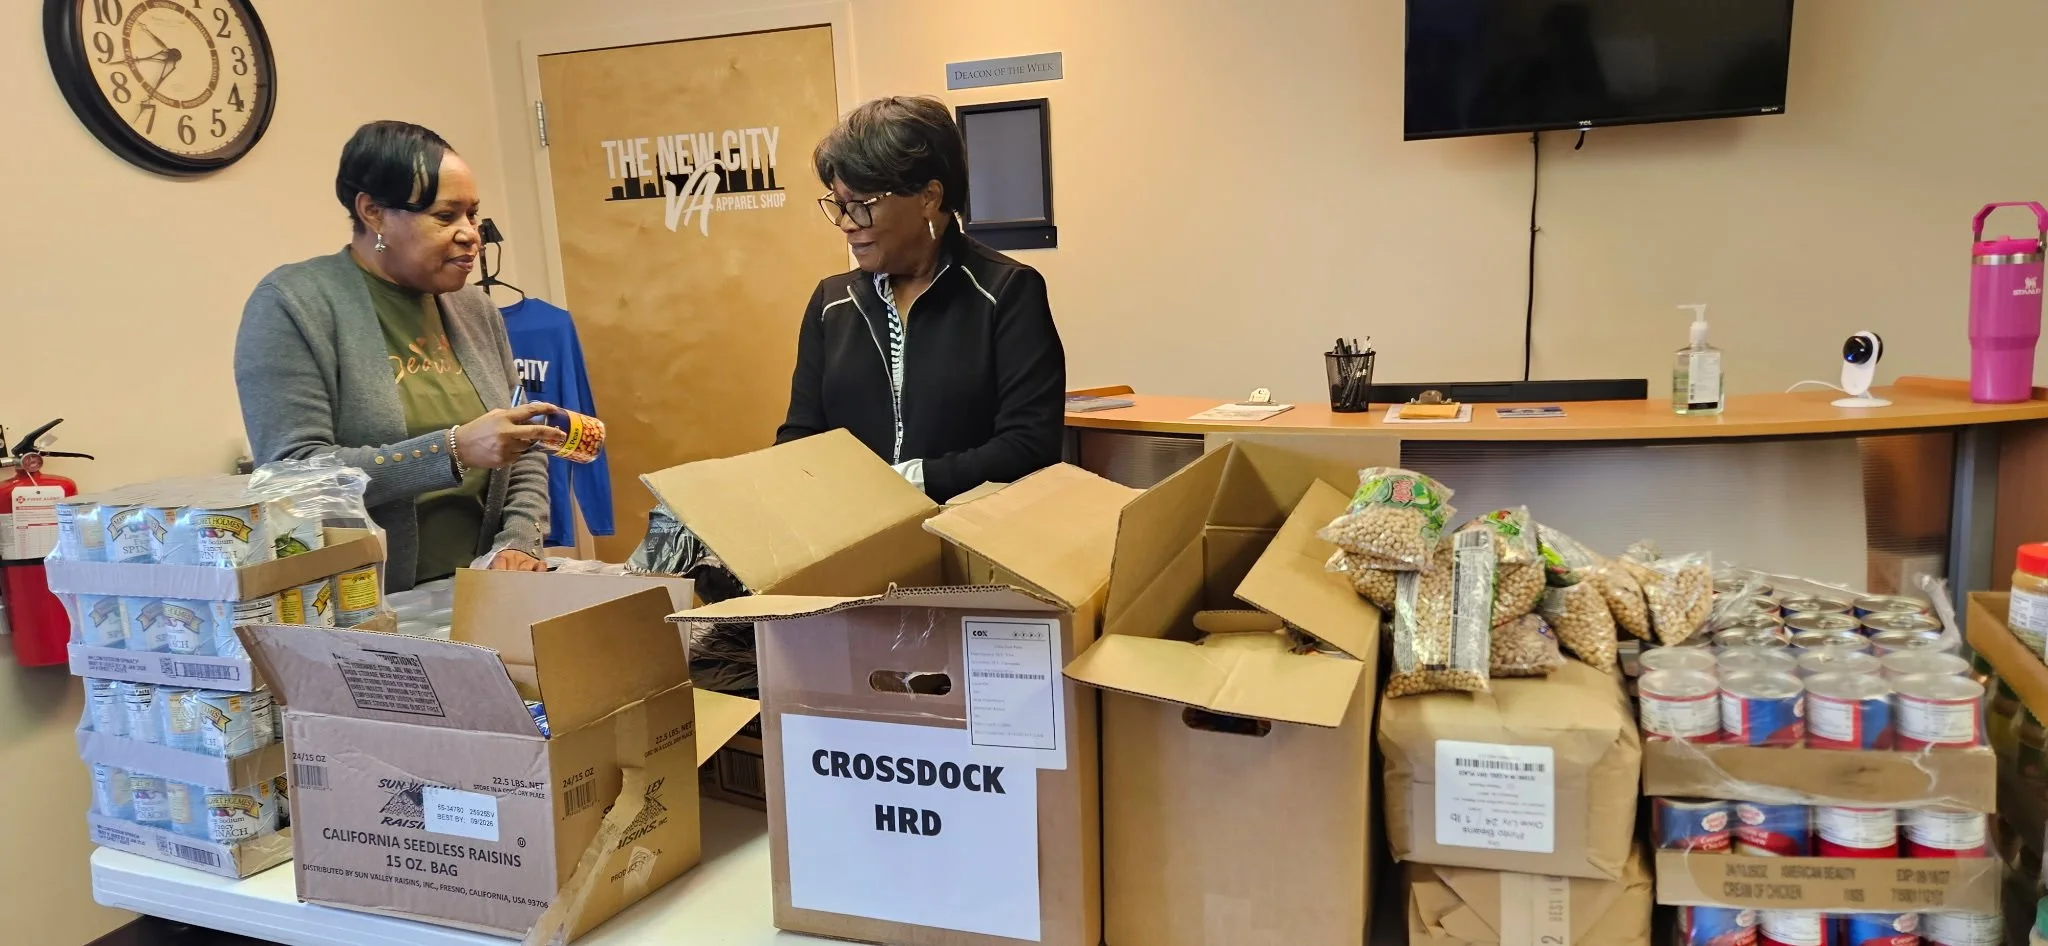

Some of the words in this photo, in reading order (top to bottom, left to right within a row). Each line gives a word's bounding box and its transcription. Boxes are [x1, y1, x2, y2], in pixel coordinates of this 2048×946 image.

[93, 0, 123, 27] 10
[213, 7, 232, 39] 2
[93, 31, 115, 64] 9
[231, 46, 248, 76] 3
[110, 71, 132, 104] 8
[227, 82, 245, 112] 4
[140, 103, 156, 135] 7
[177, 115, 197, 145] 6
[210, 108, 227, 138] 5
[601, 137, 652, 180] THE
[656, 131, 715, 177] NEW
[721, 126, 779, 172] CITY
[715, 194, 759, 212] APPAREL
[760, 192, 786, 209] SHOP
[513, 358, 549, 382] CITY
[292, 752, 314, 762] 24/15
[315, 755, 327, 763] OZ
[378, 778, 404, 790] SUN
[492, 776, 509, 786] 22.5
[511, 779, 528, 788] LBS.
[529, 781, 545, 791] NET
[562, 772, 583, 789] 24/15
[584, 767, 595, 777] OZ
[812, 749, 1006, 795] CROSSDOCK
[473, 784, 490, 792] STORE
[529, 791, 545, 800] PLACE
[437, 813, 454, 821] BEST
[455, 815, 466, 824] BY:
[470, 817, 494, 827] 09/2026
[875, 804, 942, 837] HRD
[1462, 826, 1495, 838] Beans
[323, 827, 400, 850] CALIFORNIA
[404, 837, 465, 859] SEEDLESS
[468, 847, 521, 868] RAISINS
[386, 854, 402, 869] 15
[405, 857, 427, 873] OZ.
[431, 861, 458, 877] BAG
[1780, 864, 1821, 880] AMERICAN
[1822, 866, 1857, 881] BEAUTY
[302, 863, 344, 876] DISTRIBUTED
[345, 869, 354, 877] BY
[354, 871, 369, 880] SUN
[369, 873, 393, 883] VALLEY
[394, 875, 422, 889] RAISINS,
[440, 883, 468, 896] FRESNO,
[469, 888, 511, 904] CALIFORNIA,
[512, 896, 527, 905] USA
[527, 899, 549, 909] 93706
[1723, 881, 1752, 898] CREAM
[1753, 884, 1765, 899] OF
[1765, 883, 1802, 900] CHICKEN
